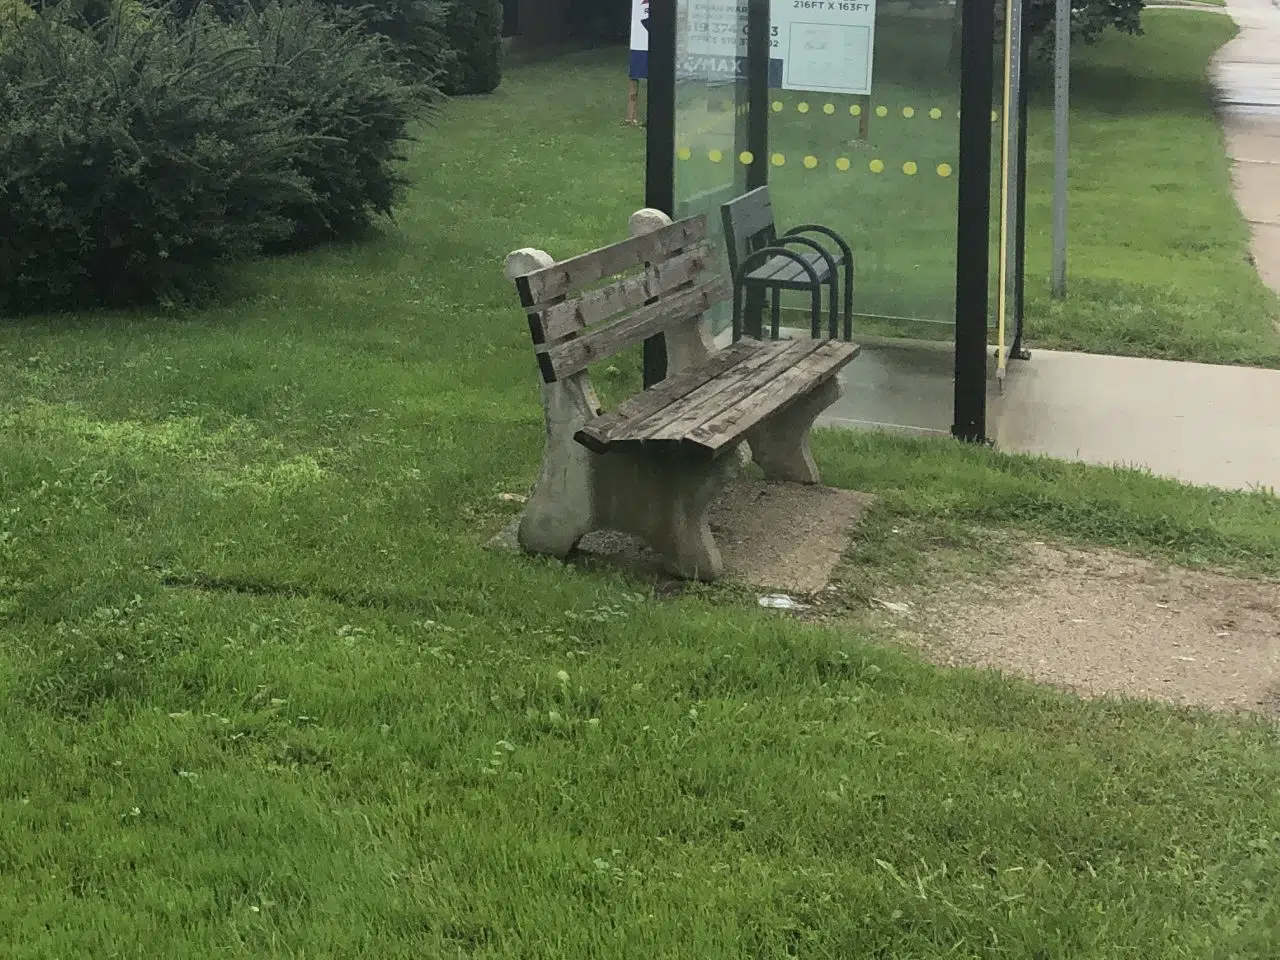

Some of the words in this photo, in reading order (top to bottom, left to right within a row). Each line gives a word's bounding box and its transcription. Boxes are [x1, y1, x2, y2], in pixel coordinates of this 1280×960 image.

[793, 1, 824, 10] 216FT
[827, 2, 834, 10] X
[838, 2, 870, 12] 163FT
